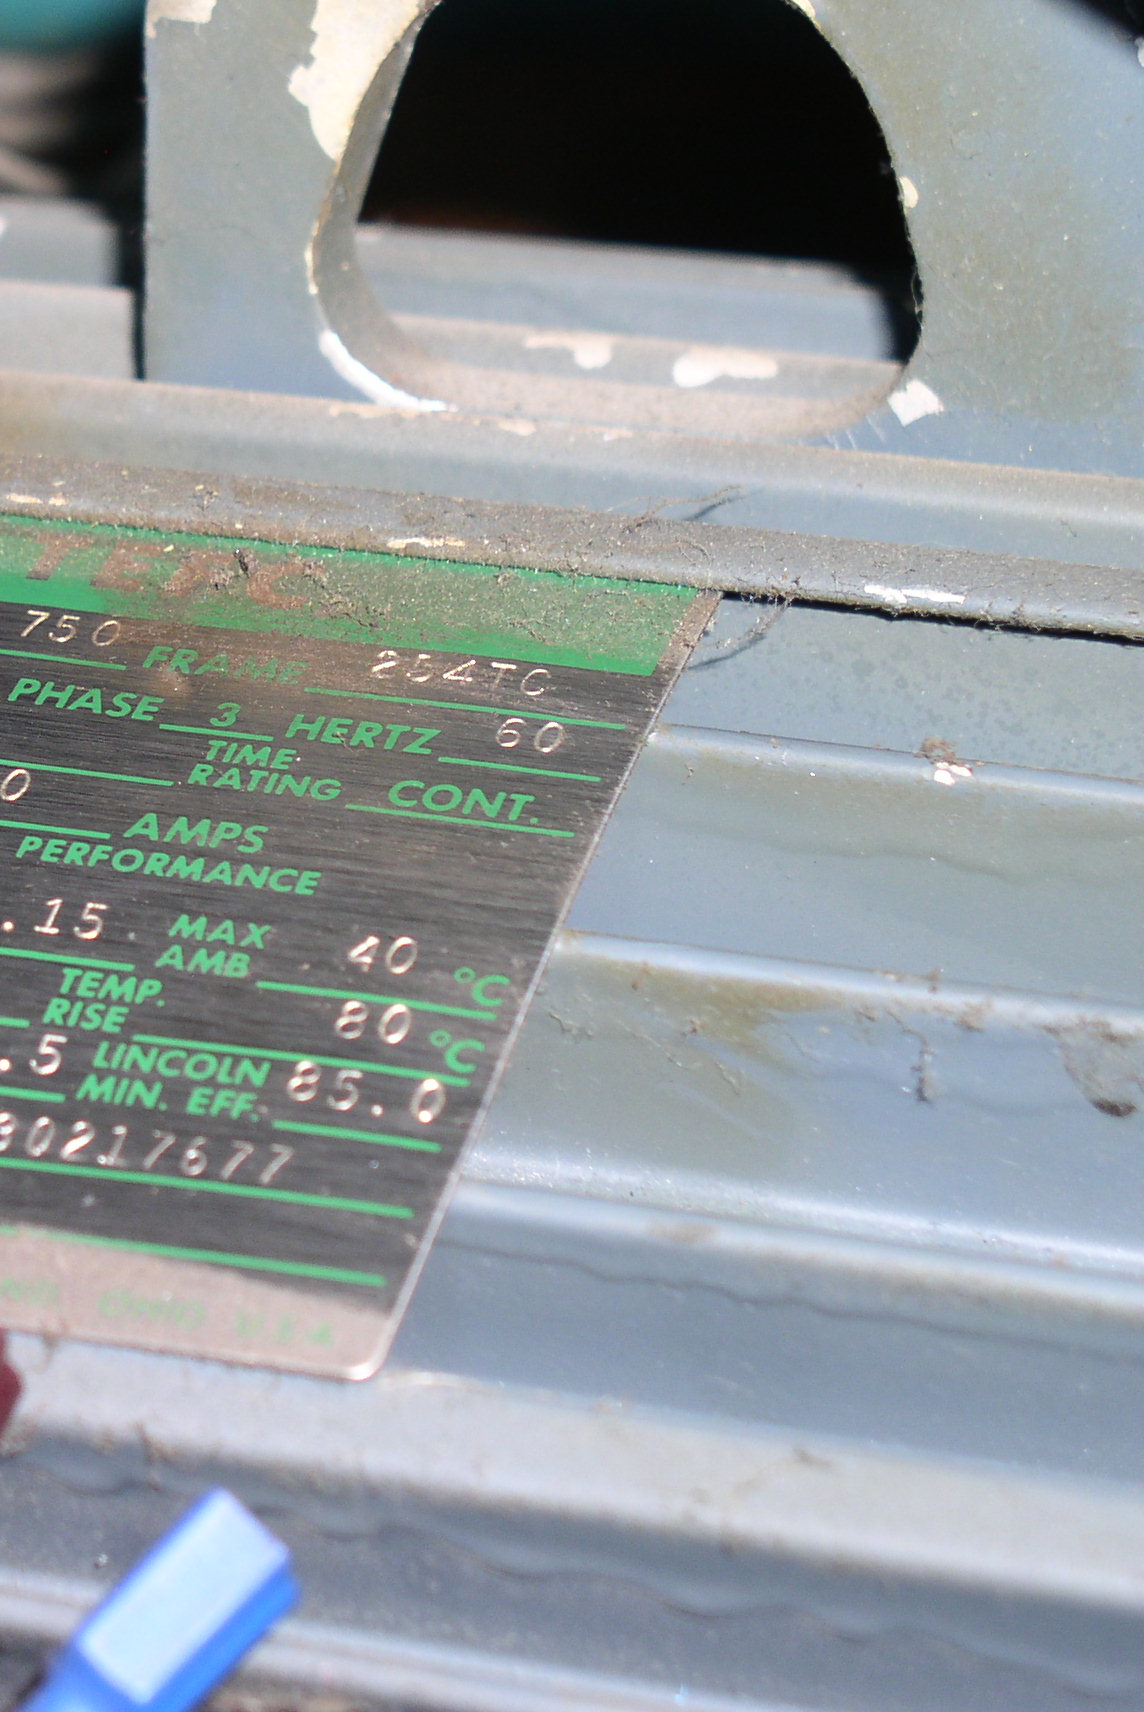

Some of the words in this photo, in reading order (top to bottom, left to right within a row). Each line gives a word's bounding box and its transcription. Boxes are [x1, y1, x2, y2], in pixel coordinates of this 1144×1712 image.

[143, 646, 307, 685] FRAME
[8, 677, 165, 721] PHASE
[209, 702, 241, 727] 3
[285, 714, 441, 755] HERTZ
[495, 717, 565, 754] 60
[206, 740, 297, 770] TIME
[187, 763, 341, 801] RATING
[388, 780, 539, 824] CONT.
[123, 812, 269, 853] AMPS
[15, 835, 322, 896] PERFORMANCE
[167, 914, 272, 949] MAX
[154, 945, 251, 978] AMB
[347, 935, 418, 975] 40
[59, 967, 165, 1006] TEMP.
[42, 997, 130, 1033] RISE
[334, 999, 413, 1044] 80
[92, 1041, 272, 1088] LINCOLN
[76, 1073, 168, 1111] MIN.
[186, 1085, 260, 1122] EFF.
[286, 1059, 447, 1124] 85.0
